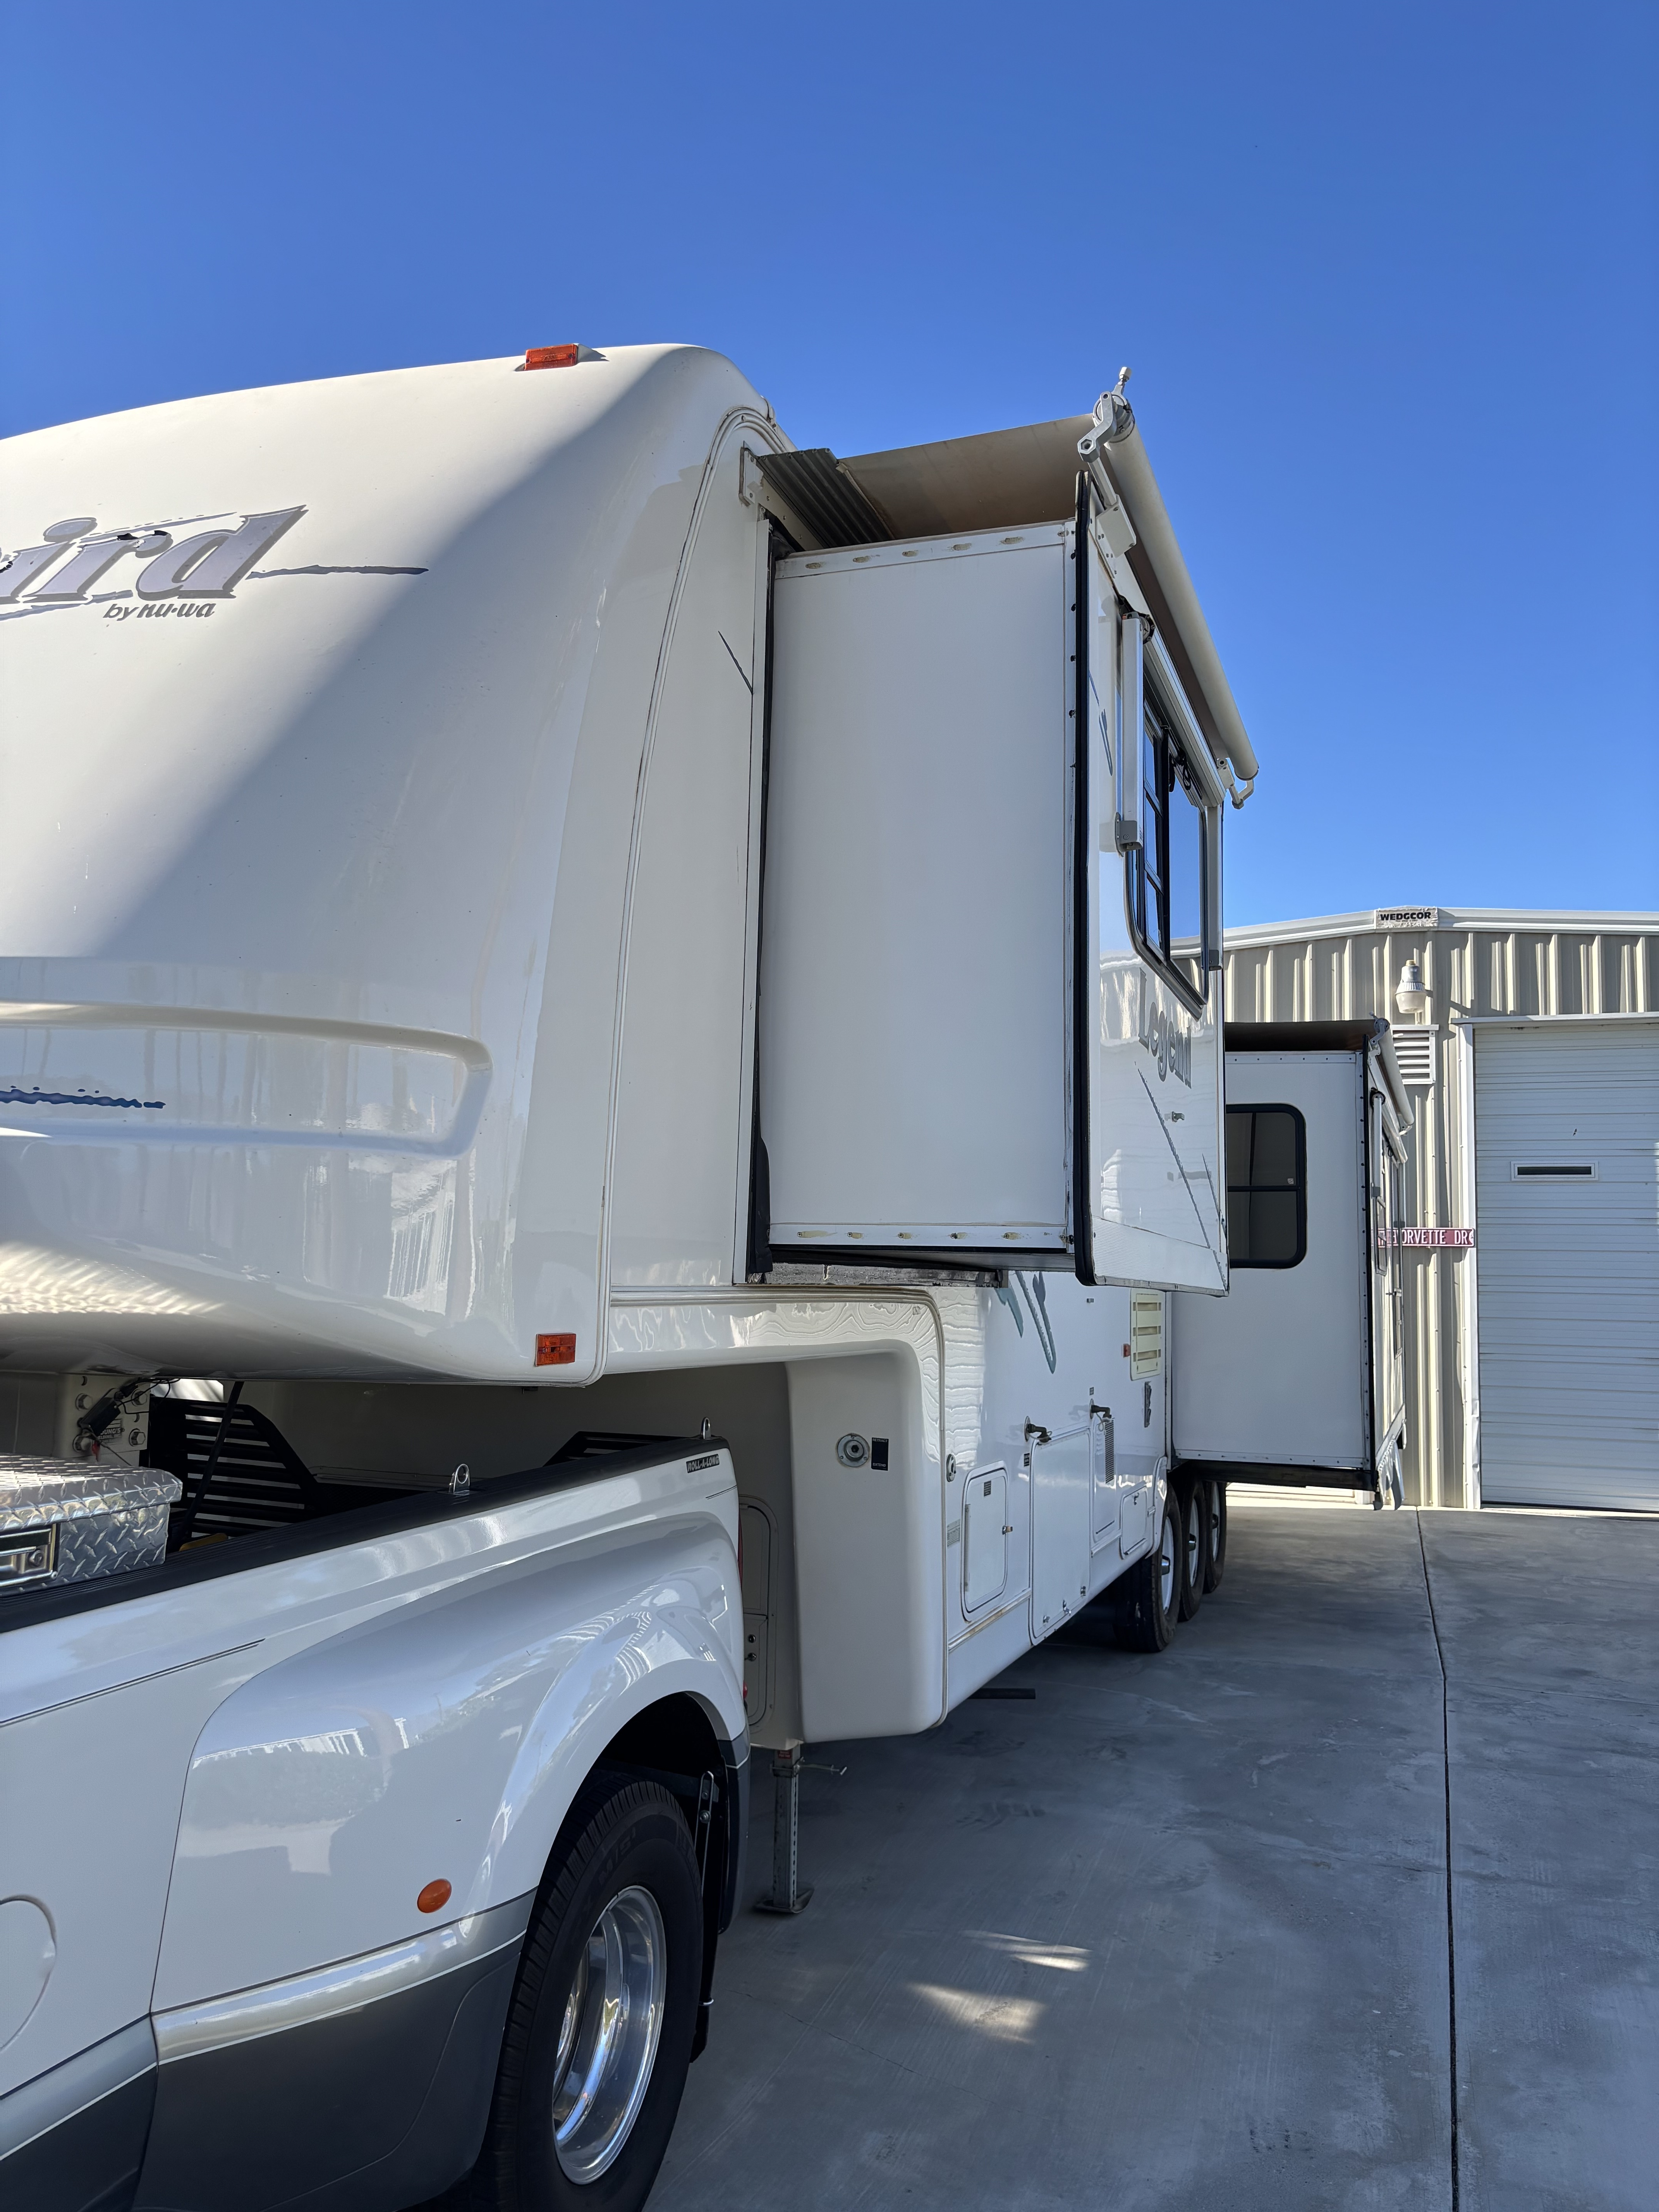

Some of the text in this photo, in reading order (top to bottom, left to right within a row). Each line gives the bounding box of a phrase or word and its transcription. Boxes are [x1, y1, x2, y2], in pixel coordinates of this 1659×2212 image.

[0, 504, 309, 605] ird
[103, 604, 139, 621] by
[1380, 912, 1431, 921] WEDGCOR
[1401, 1229, 1468, 1244] ORVETTE DR
